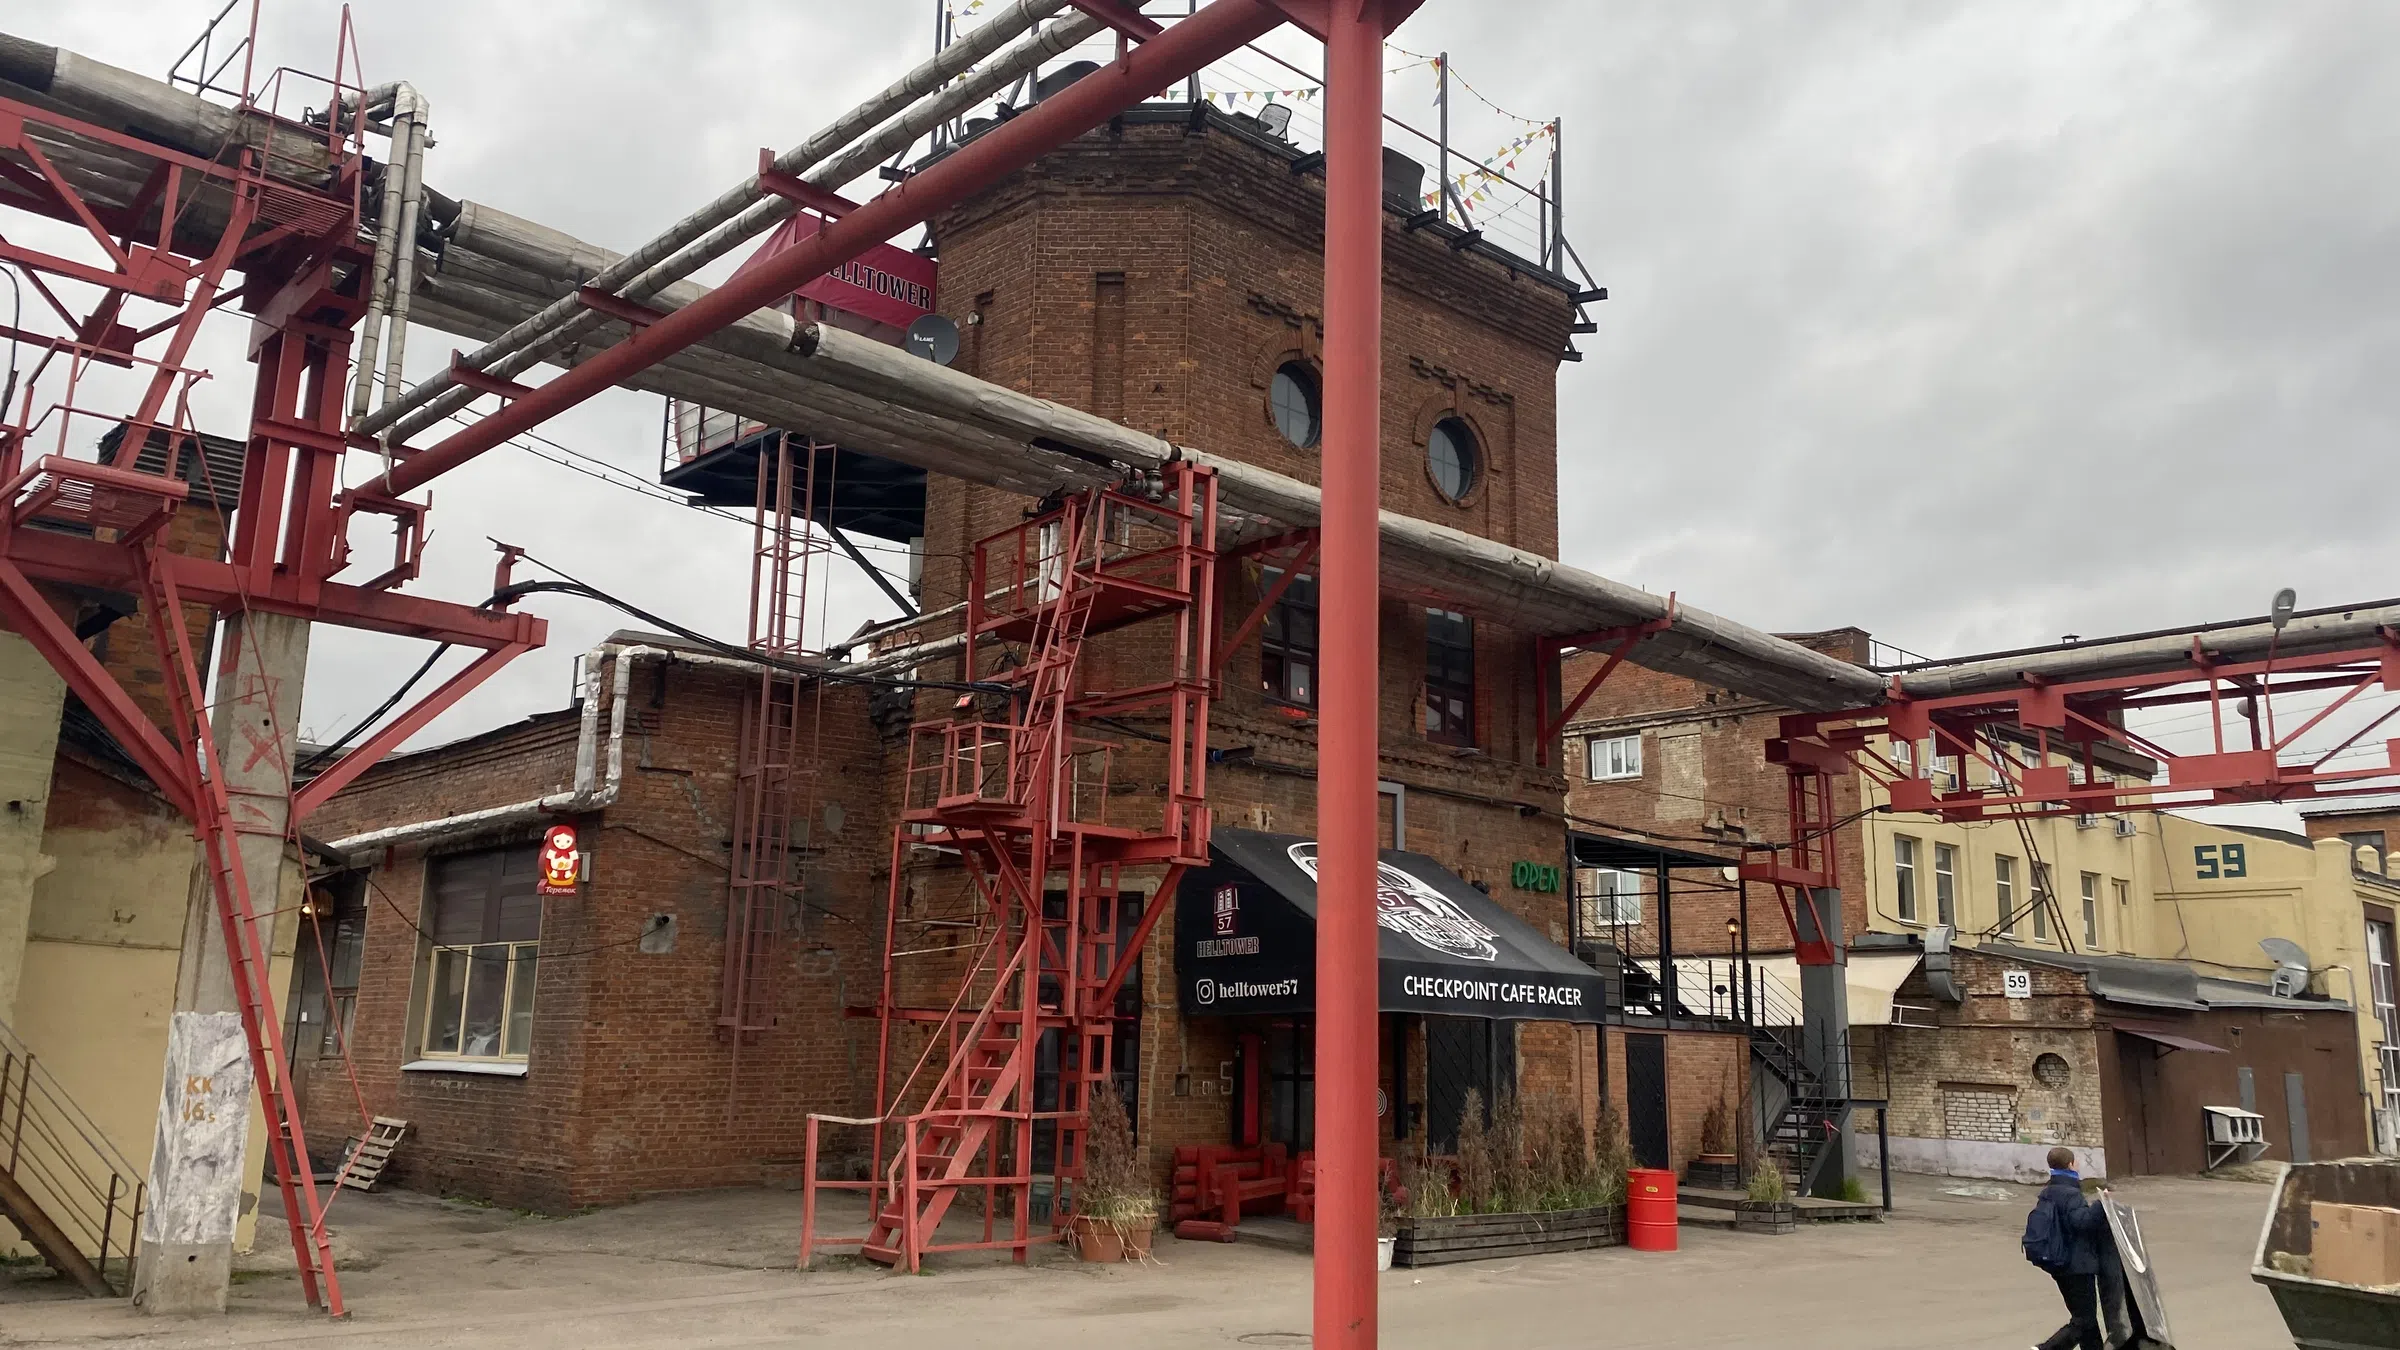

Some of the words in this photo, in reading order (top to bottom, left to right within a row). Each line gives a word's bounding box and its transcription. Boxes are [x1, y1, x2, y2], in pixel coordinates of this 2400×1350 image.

[826, 261, 932, 310] ELLTOWER
[2194, 843, 2247, 880] 59
[1512, 861, 1560, 892] OPEN
[545, 886, 576, 895] Теремок
[1217, 916, 1232, 930] 57
[1196, 936, 1260, 958] HELLTOWER
[1219, 979, 1298, 998] helltower57
[1403, 975, 1499, 1001] CHECKPOINT
[1500, 983, 1536, 1004] CAFE
[1538, 986, 1582, 1006] RACER
[2008, 975, 2027, 988] 59
